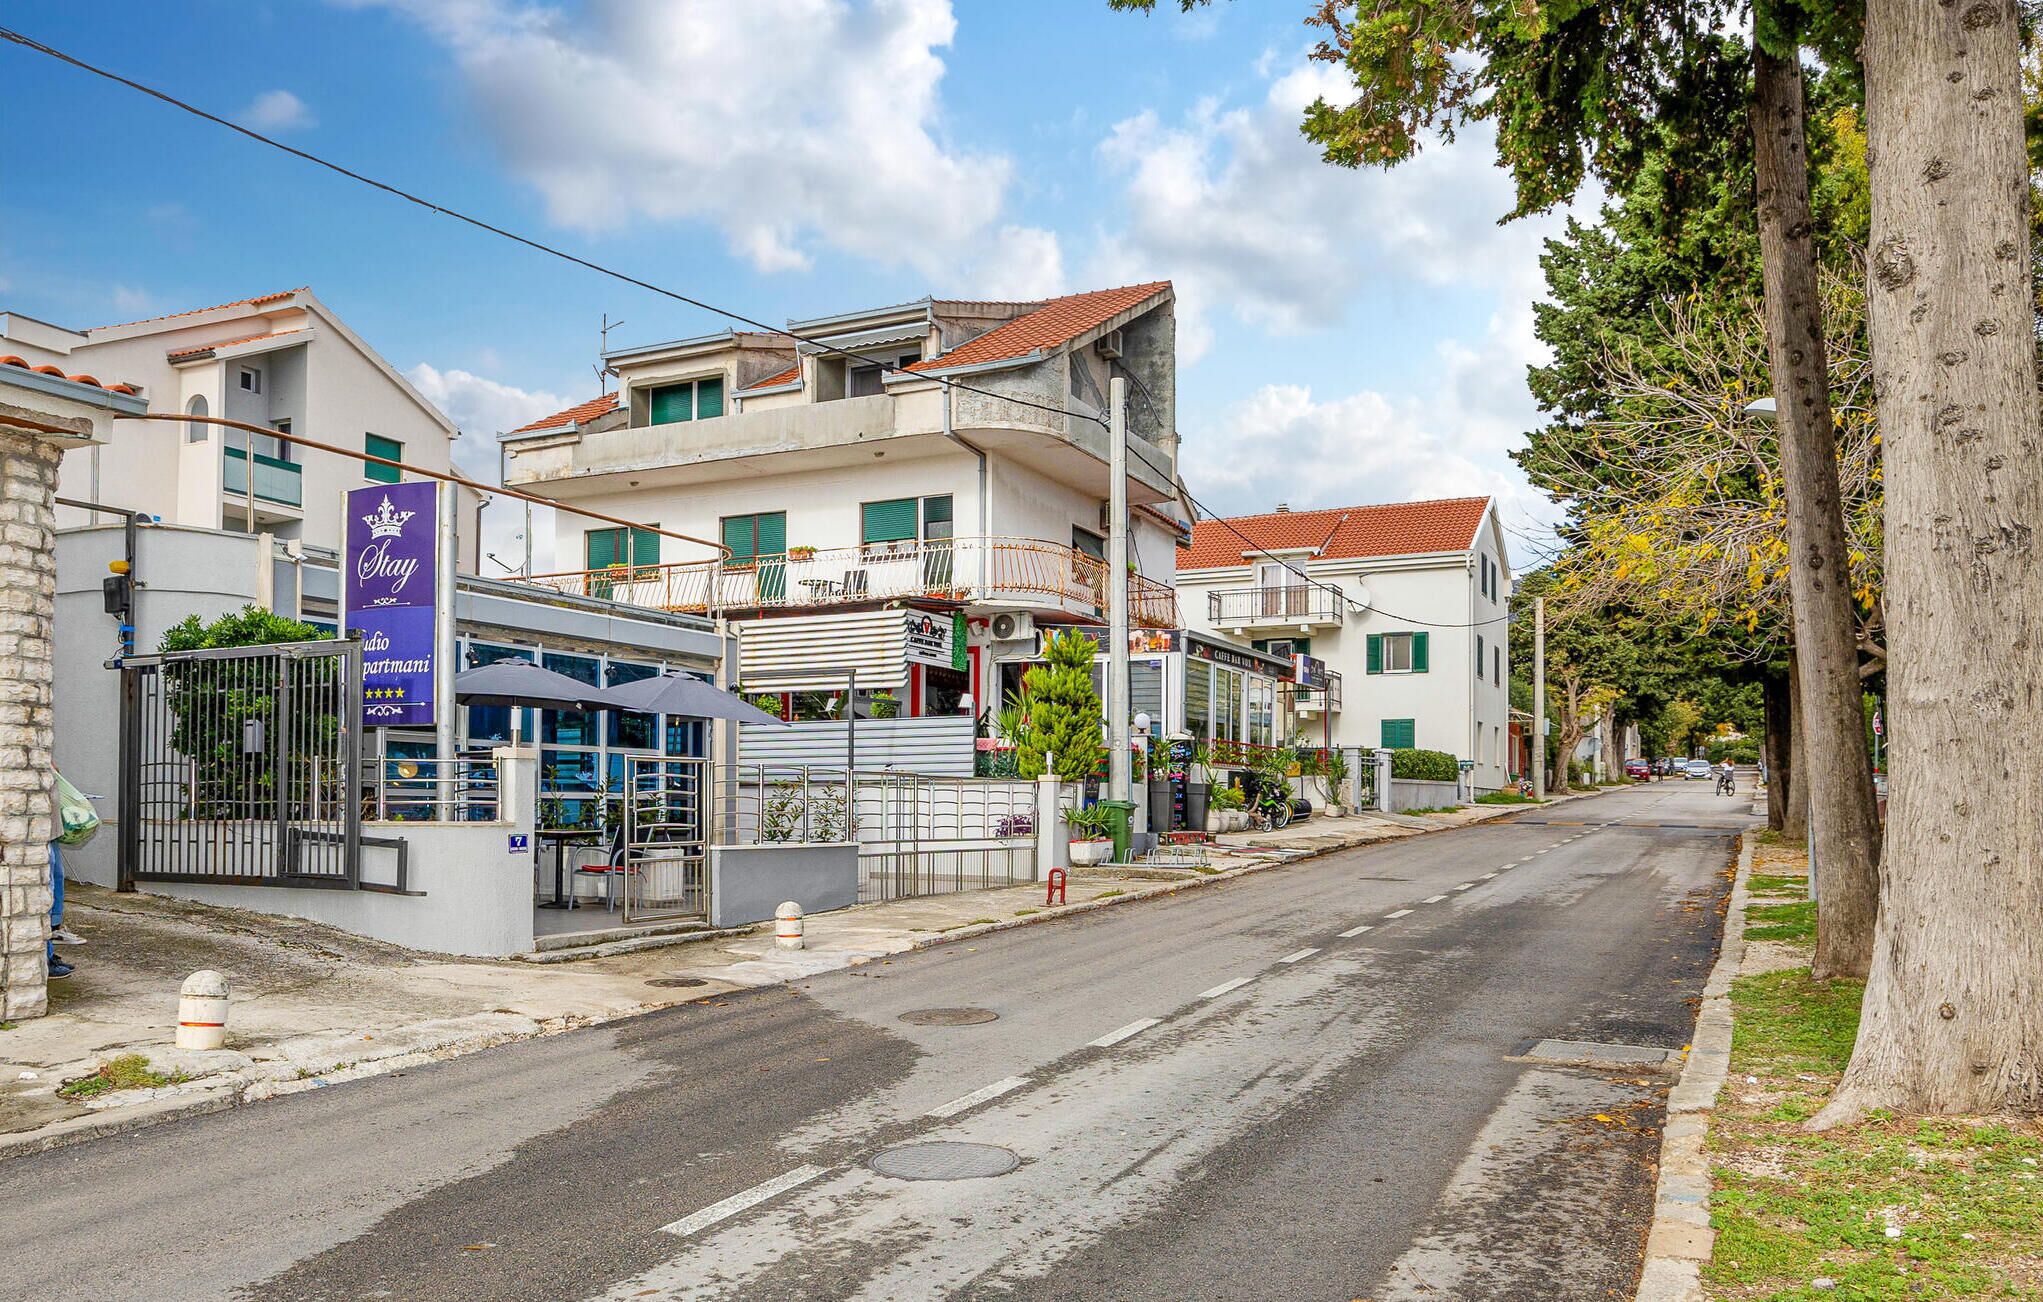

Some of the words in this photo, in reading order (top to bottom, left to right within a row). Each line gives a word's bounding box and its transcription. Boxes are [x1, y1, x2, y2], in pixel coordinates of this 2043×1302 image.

[358, 538, 419, 594] Stay
[363, 630, 390, 652] udio
[362, 654, 431, 681] partmani
[514, 836, 523, 847] 7
